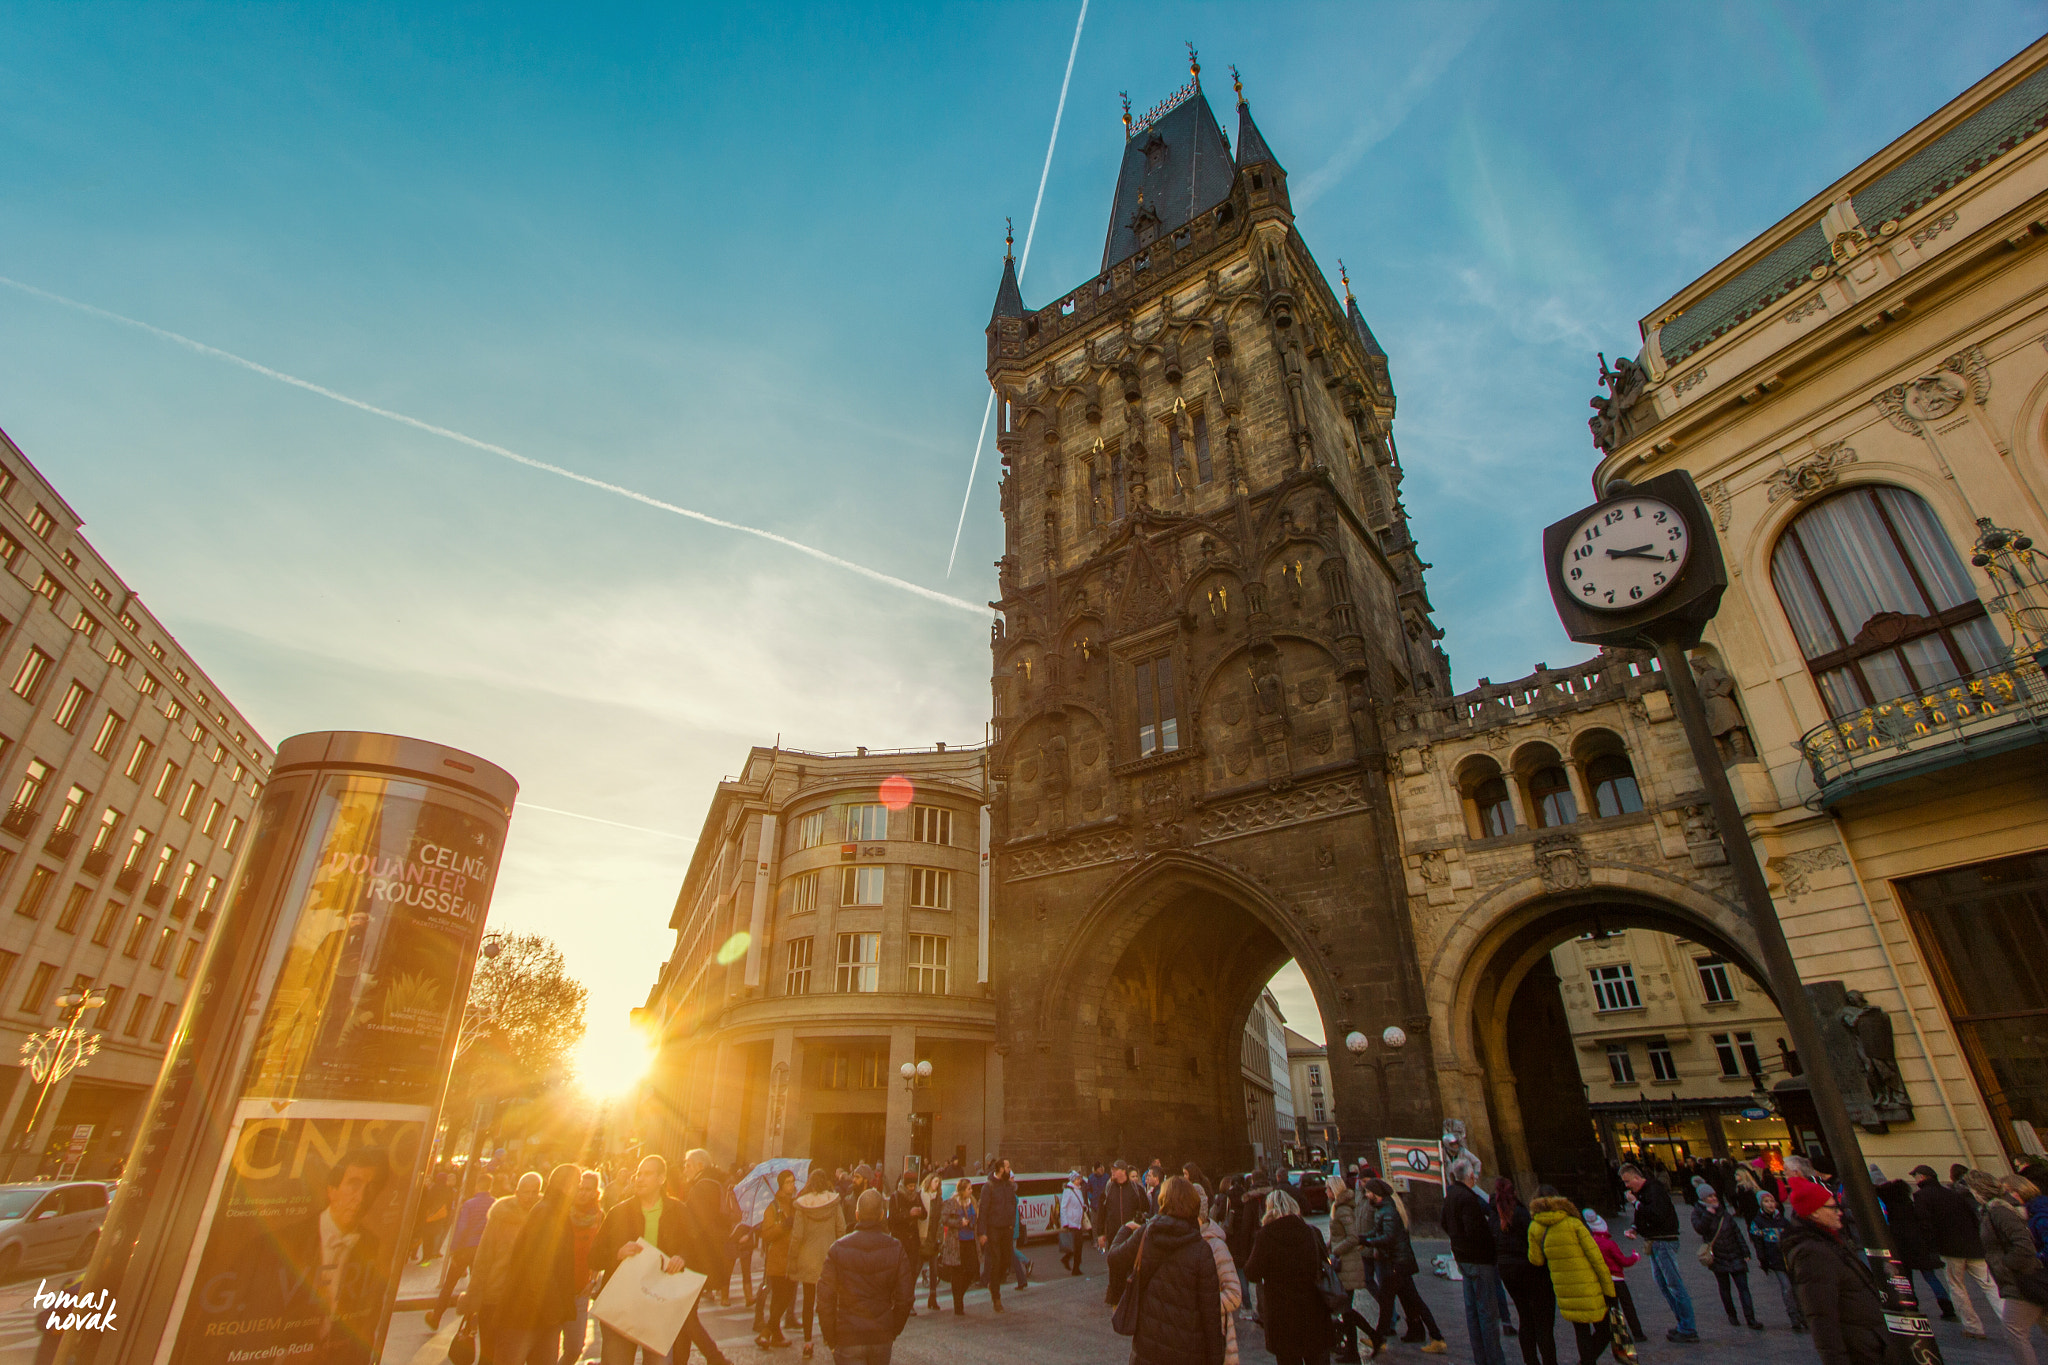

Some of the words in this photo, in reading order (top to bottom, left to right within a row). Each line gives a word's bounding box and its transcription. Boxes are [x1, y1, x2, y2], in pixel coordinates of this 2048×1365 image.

[1603, 509, 1624, 526] 12
[1632, 505, 1643, 519] 1
[1653, 510, 1667, 525] 2
[1584, 524, 1603, 541] 11
[1667, 526, 1682, 541] 3
[1573, 544, 1593, 562] 10
[1665, 549, 1679, 563] 4
[1570, 567, 1583, 581] 9
[1653, 571, 1667, 586] 5
[1582, 582, 1597, 597] 8
[1603, 589, 1615, 604] 7
[1629, 585, 1643, 599] 6
[862, 846, 886, 857] KB
[328, 851, 467, 896] DOUANIER
[366, 878, 480, 924] ROUSSEAU
[1018, 1202, 1047, 1219] RLING
[205, 1317, 283, 1337] REQUIEM
[227, 1344, 285, 1363] Marcello
[285, 1342, 314, 1356] Rota
